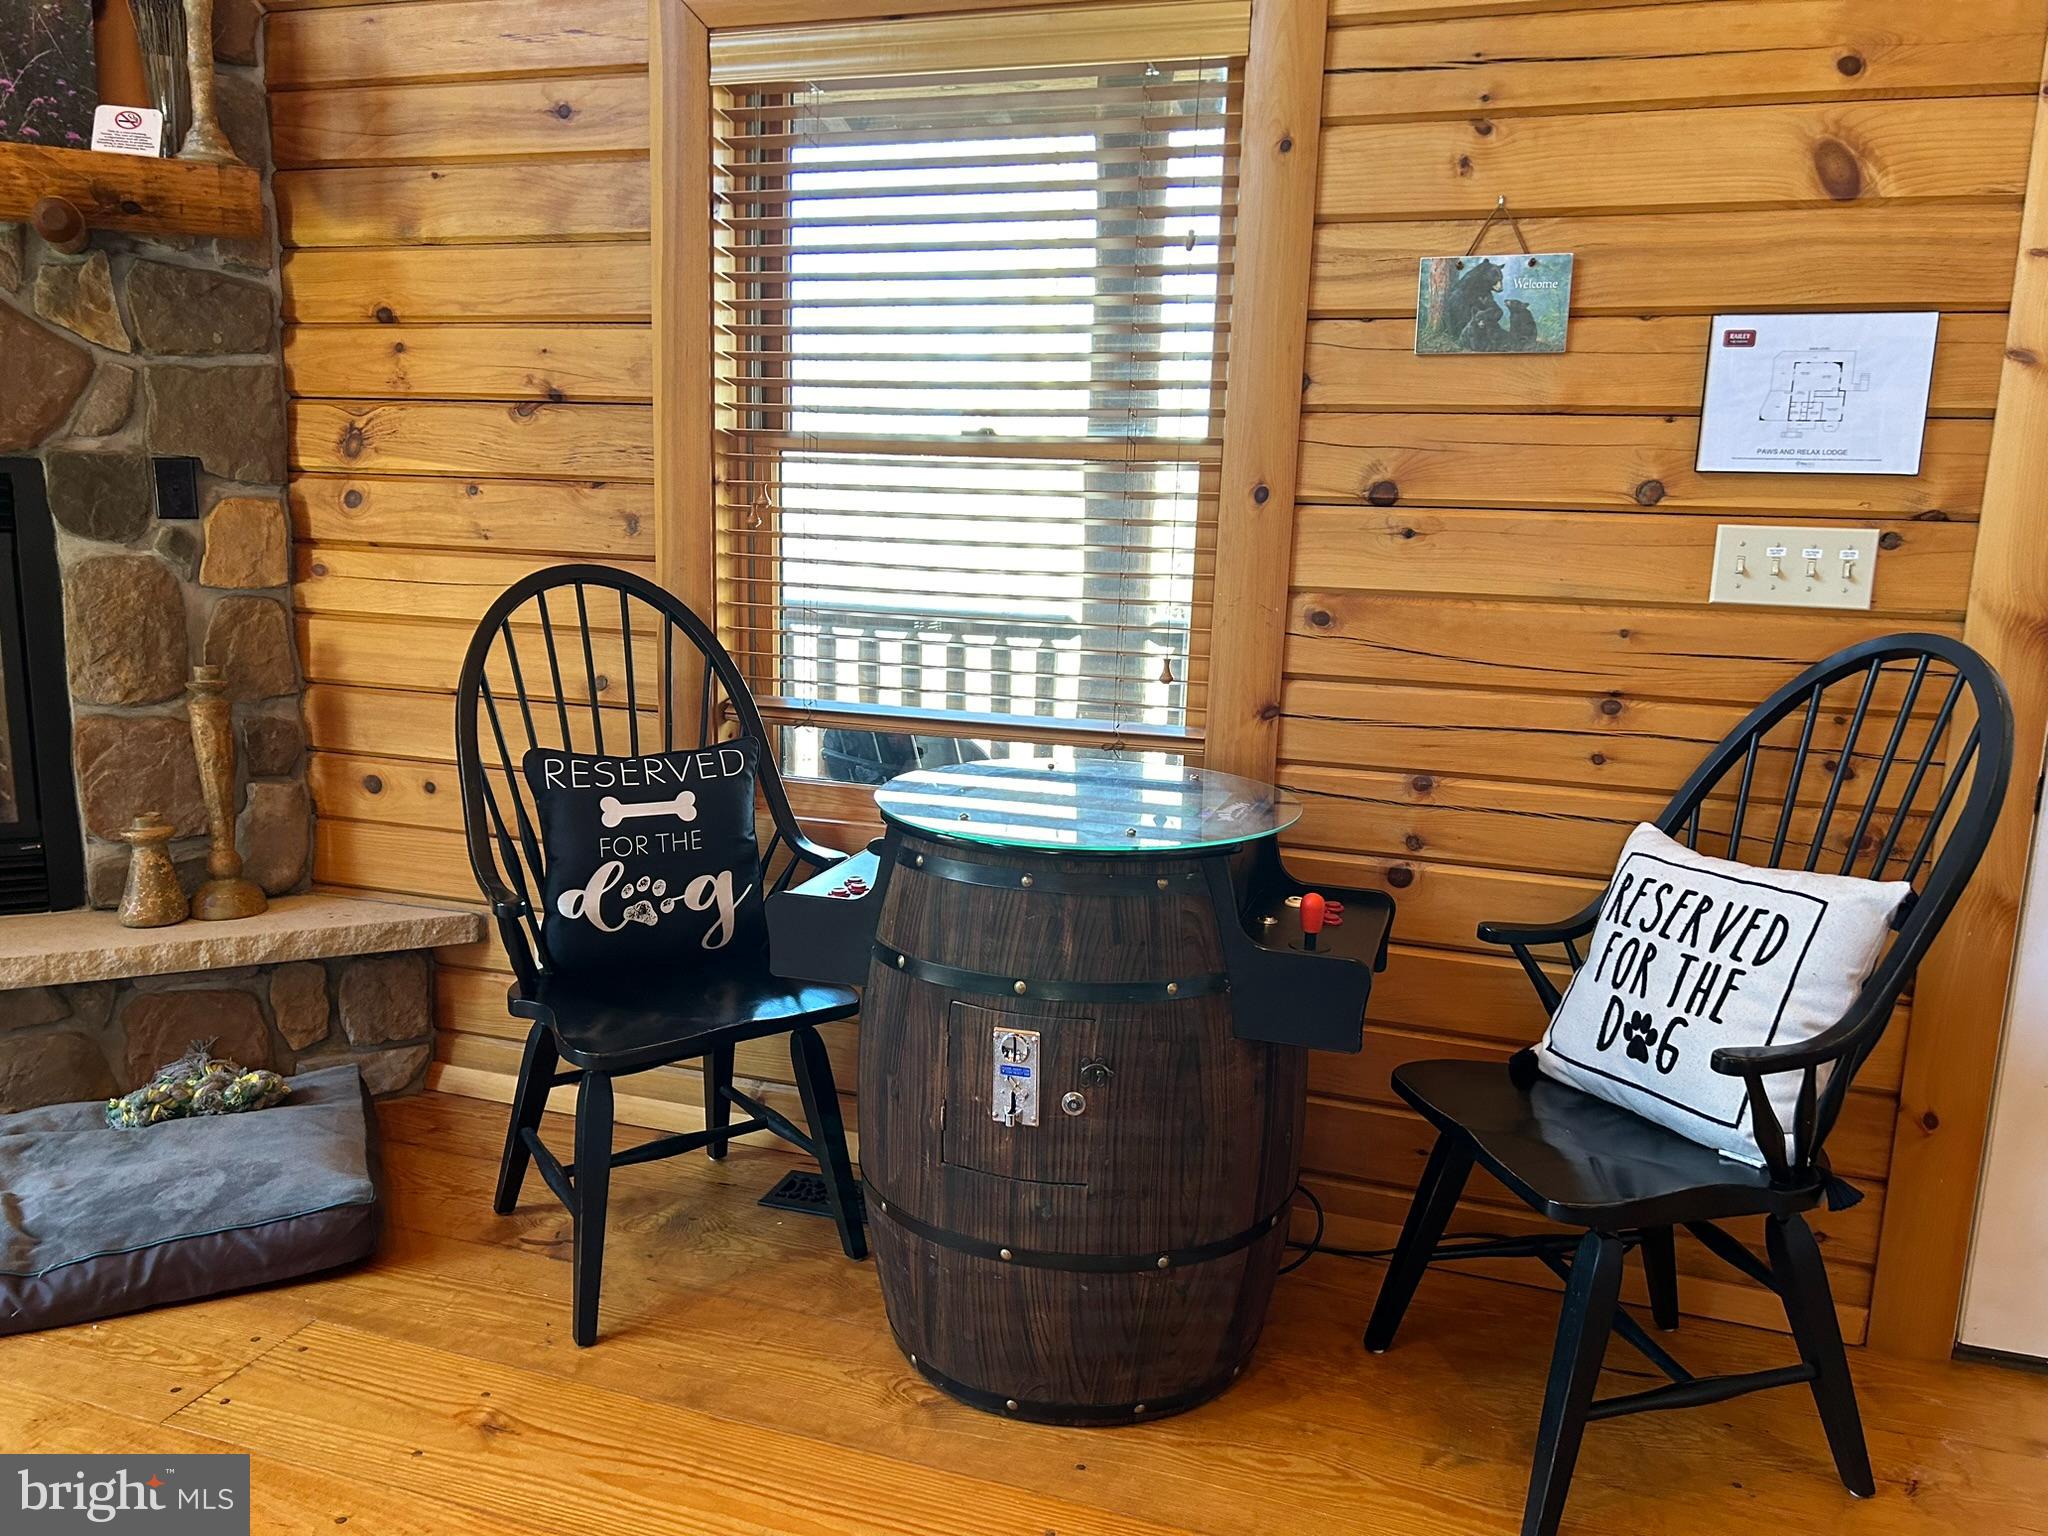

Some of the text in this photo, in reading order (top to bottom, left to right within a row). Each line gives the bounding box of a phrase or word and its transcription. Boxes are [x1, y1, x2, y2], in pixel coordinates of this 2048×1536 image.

[1513, 277, 1559, 289] Welcome
[544, 749, 745, 790] RESERVED
[599, 829, 703, 858] FOR THE
[1605, 872, 1790, 967] RESERVED
[1594, 931, 1747, 1024] FOR THE
